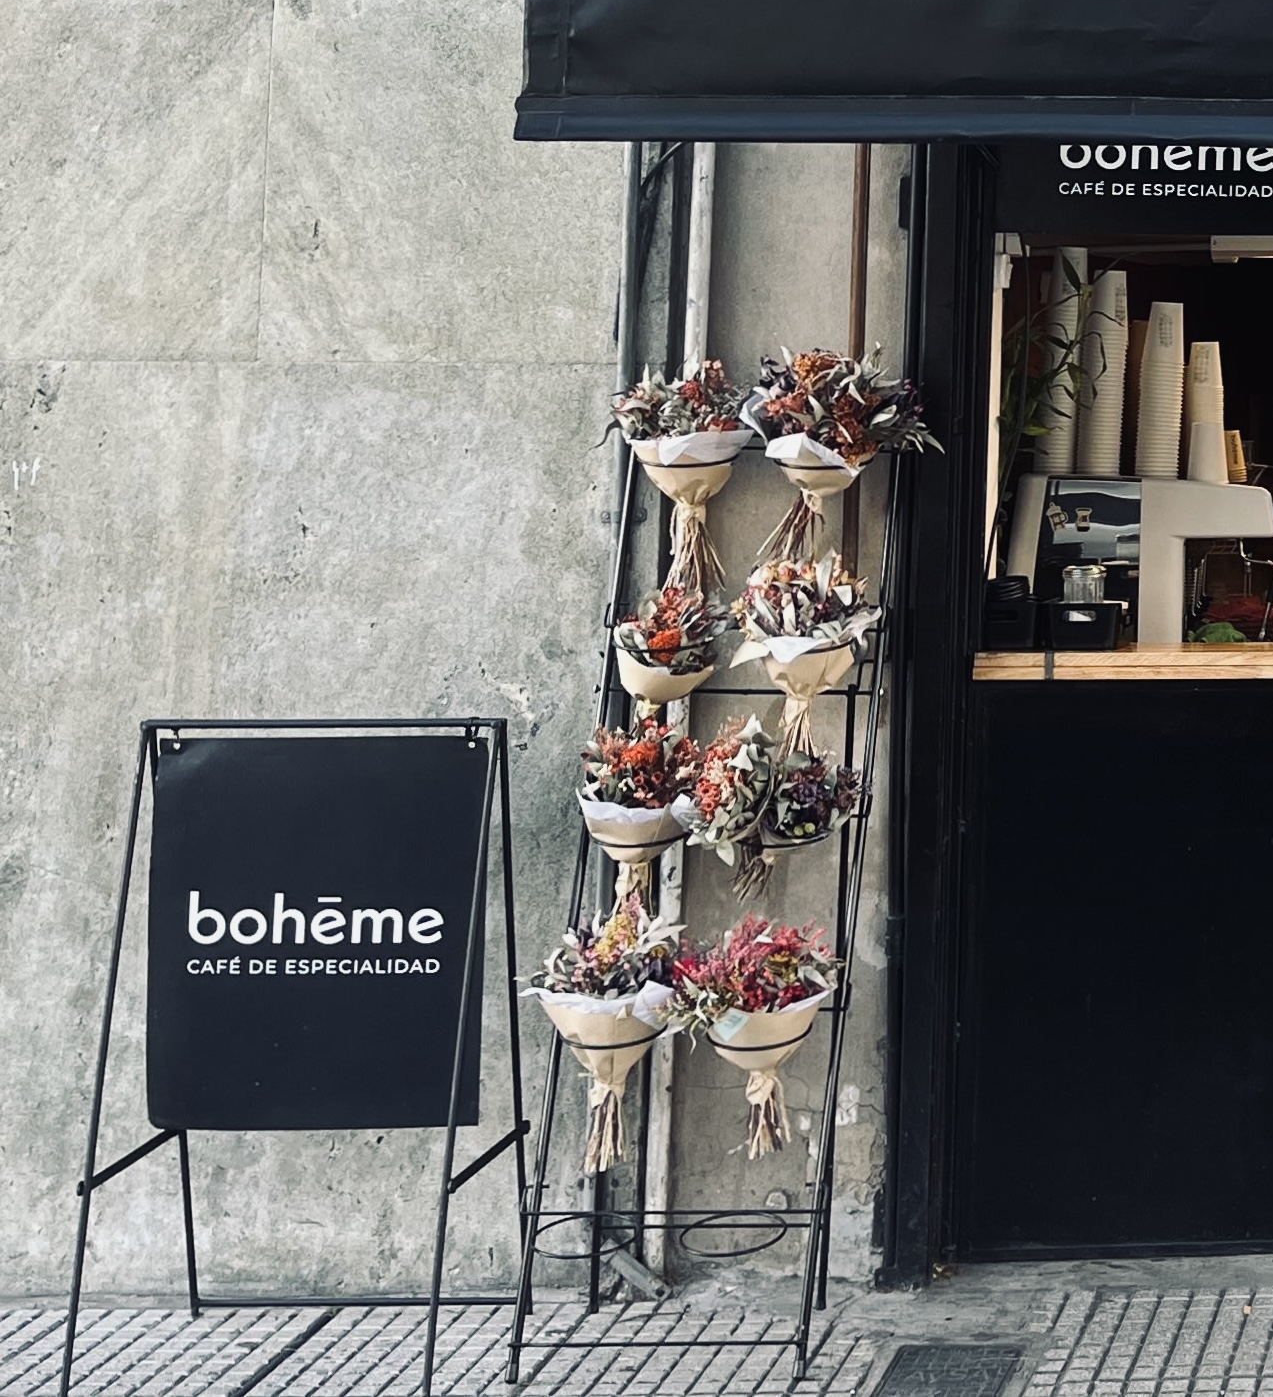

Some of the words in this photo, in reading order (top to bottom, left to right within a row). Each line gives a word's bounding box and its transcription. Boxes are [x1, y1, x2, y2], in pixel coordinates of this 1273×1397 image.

[1058, 180, 1105, 196] CAFÉ
[1111, 183, 1135, 196] DE
[1142, 183, 1273, 198] ESPECIALIDAD
[187, 890, 444, 945] bohēme
[186, 956, 241, 975] CAFÉ
[249, 959, 277, 975] DE
[285, 958, 441, 975] ESPECIALIDAD
